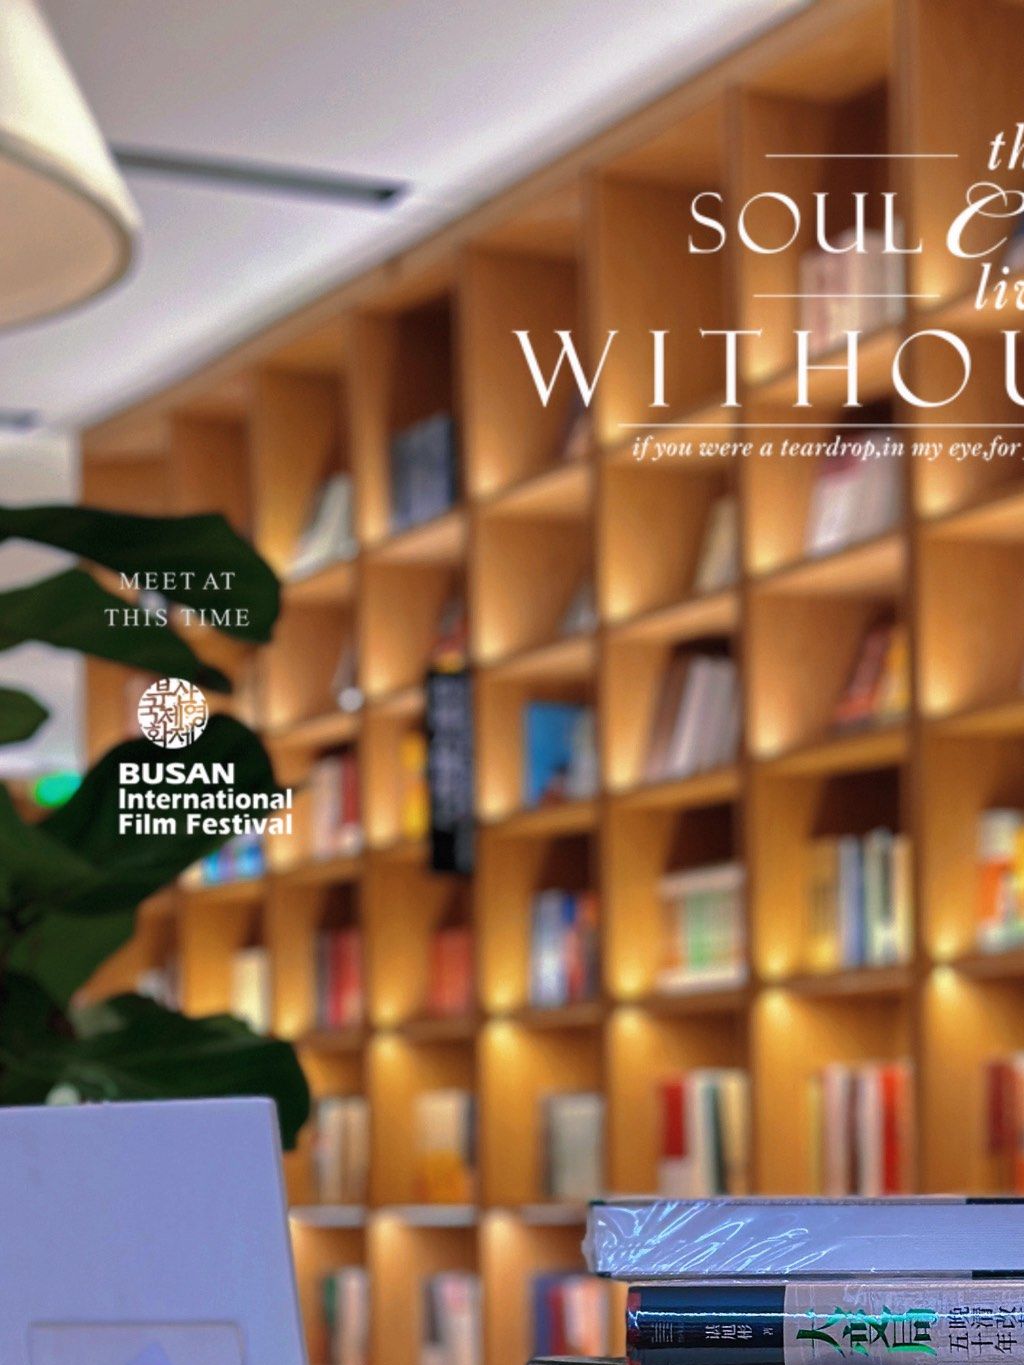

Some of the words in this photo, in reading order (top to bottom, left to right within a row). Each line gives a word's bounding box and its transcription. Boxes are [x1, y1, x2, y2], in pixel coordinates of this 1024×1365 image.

[796, 1306, 940, 1357] 大变局
[949, 1330, 1018, 1355] 五十年
